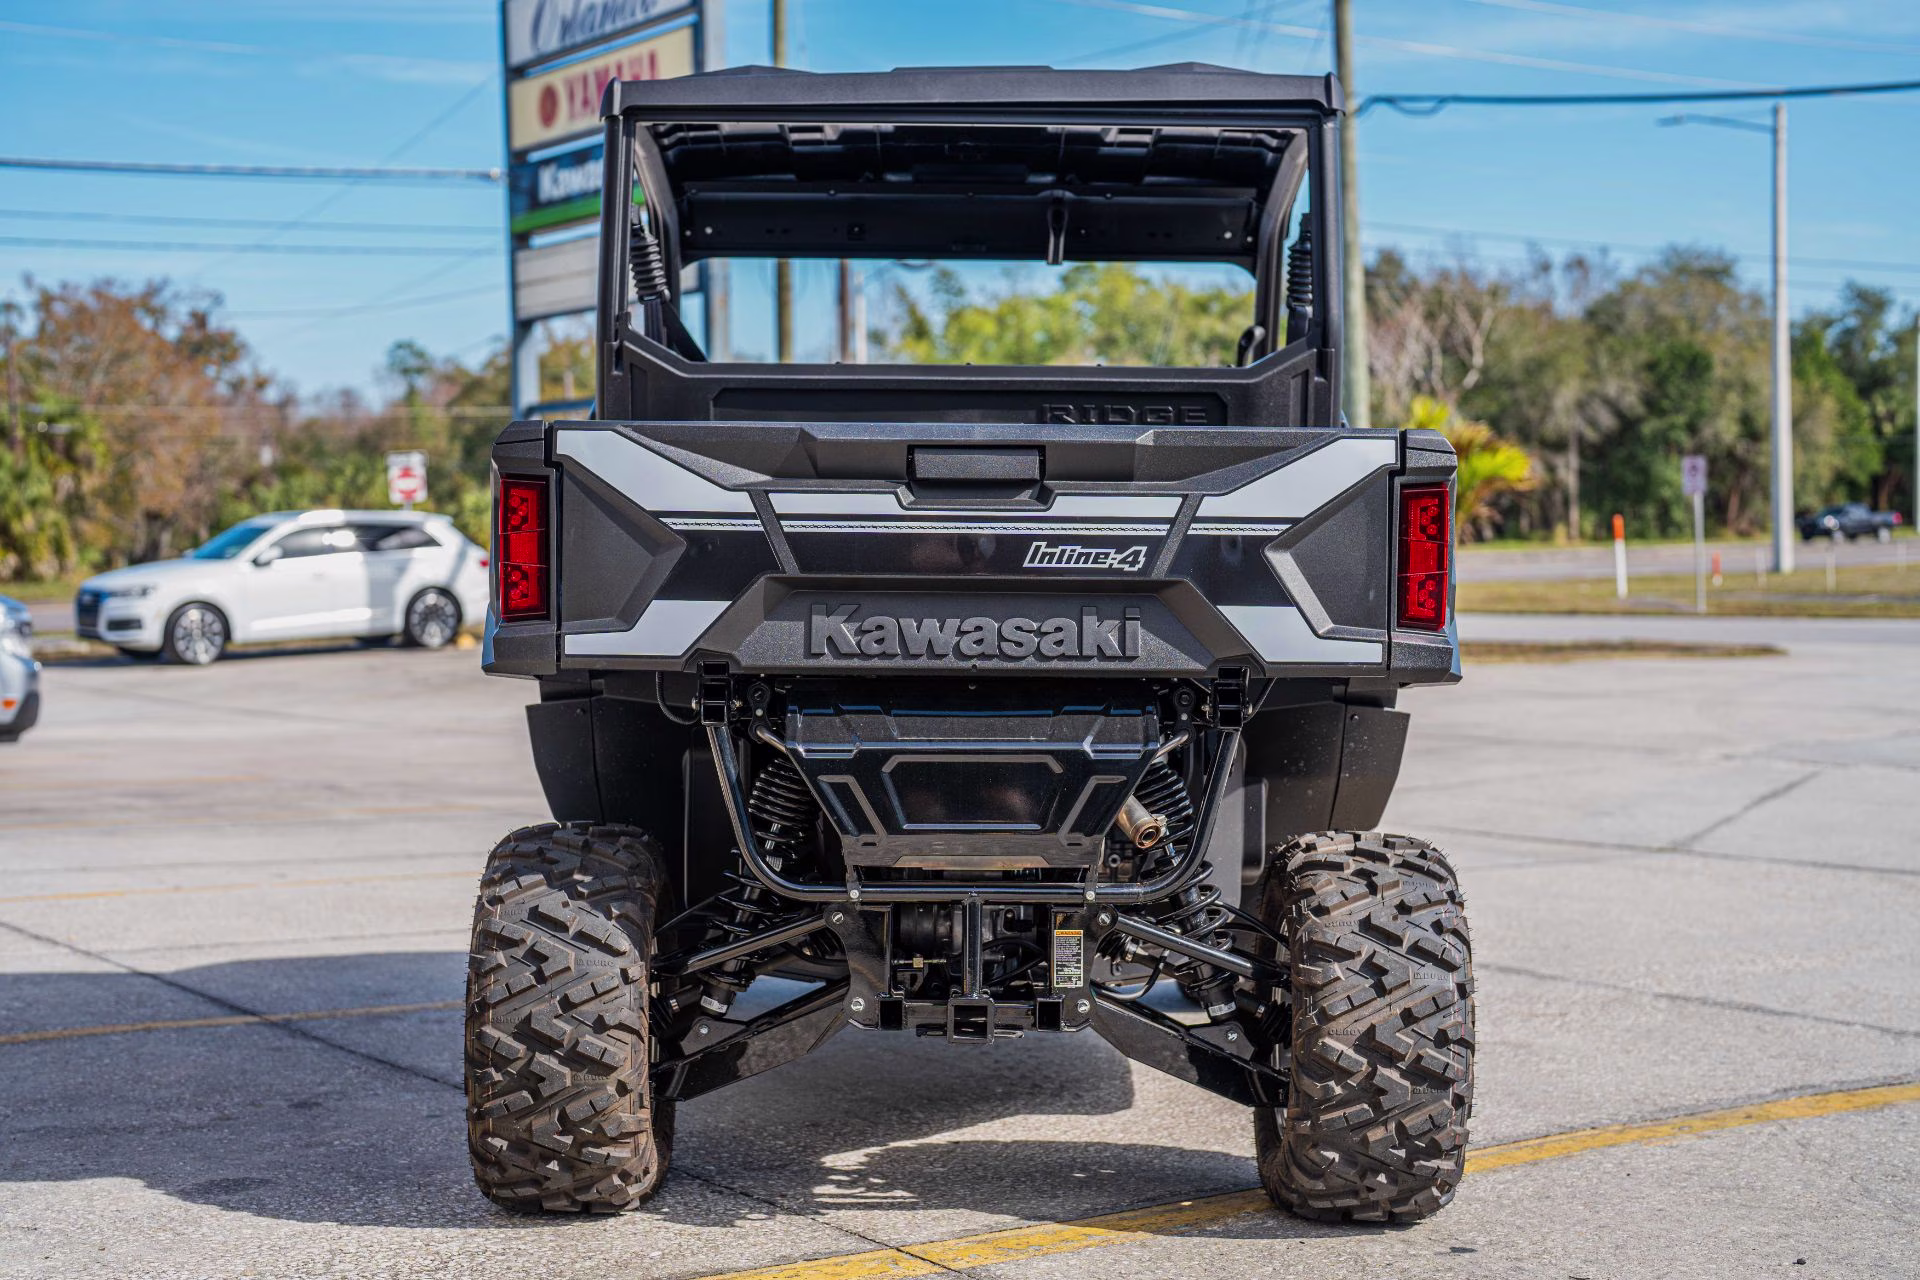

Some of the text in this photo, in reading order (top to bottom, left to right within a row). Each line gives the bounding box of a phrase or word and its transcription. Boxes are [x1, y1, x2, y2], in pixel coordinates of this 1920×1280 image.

[1041, 403, 1208, 423] RIDGE
[1023, 541, 1147, 571] Inline-4
[810, 604, 1141, 657] Kawasaki
